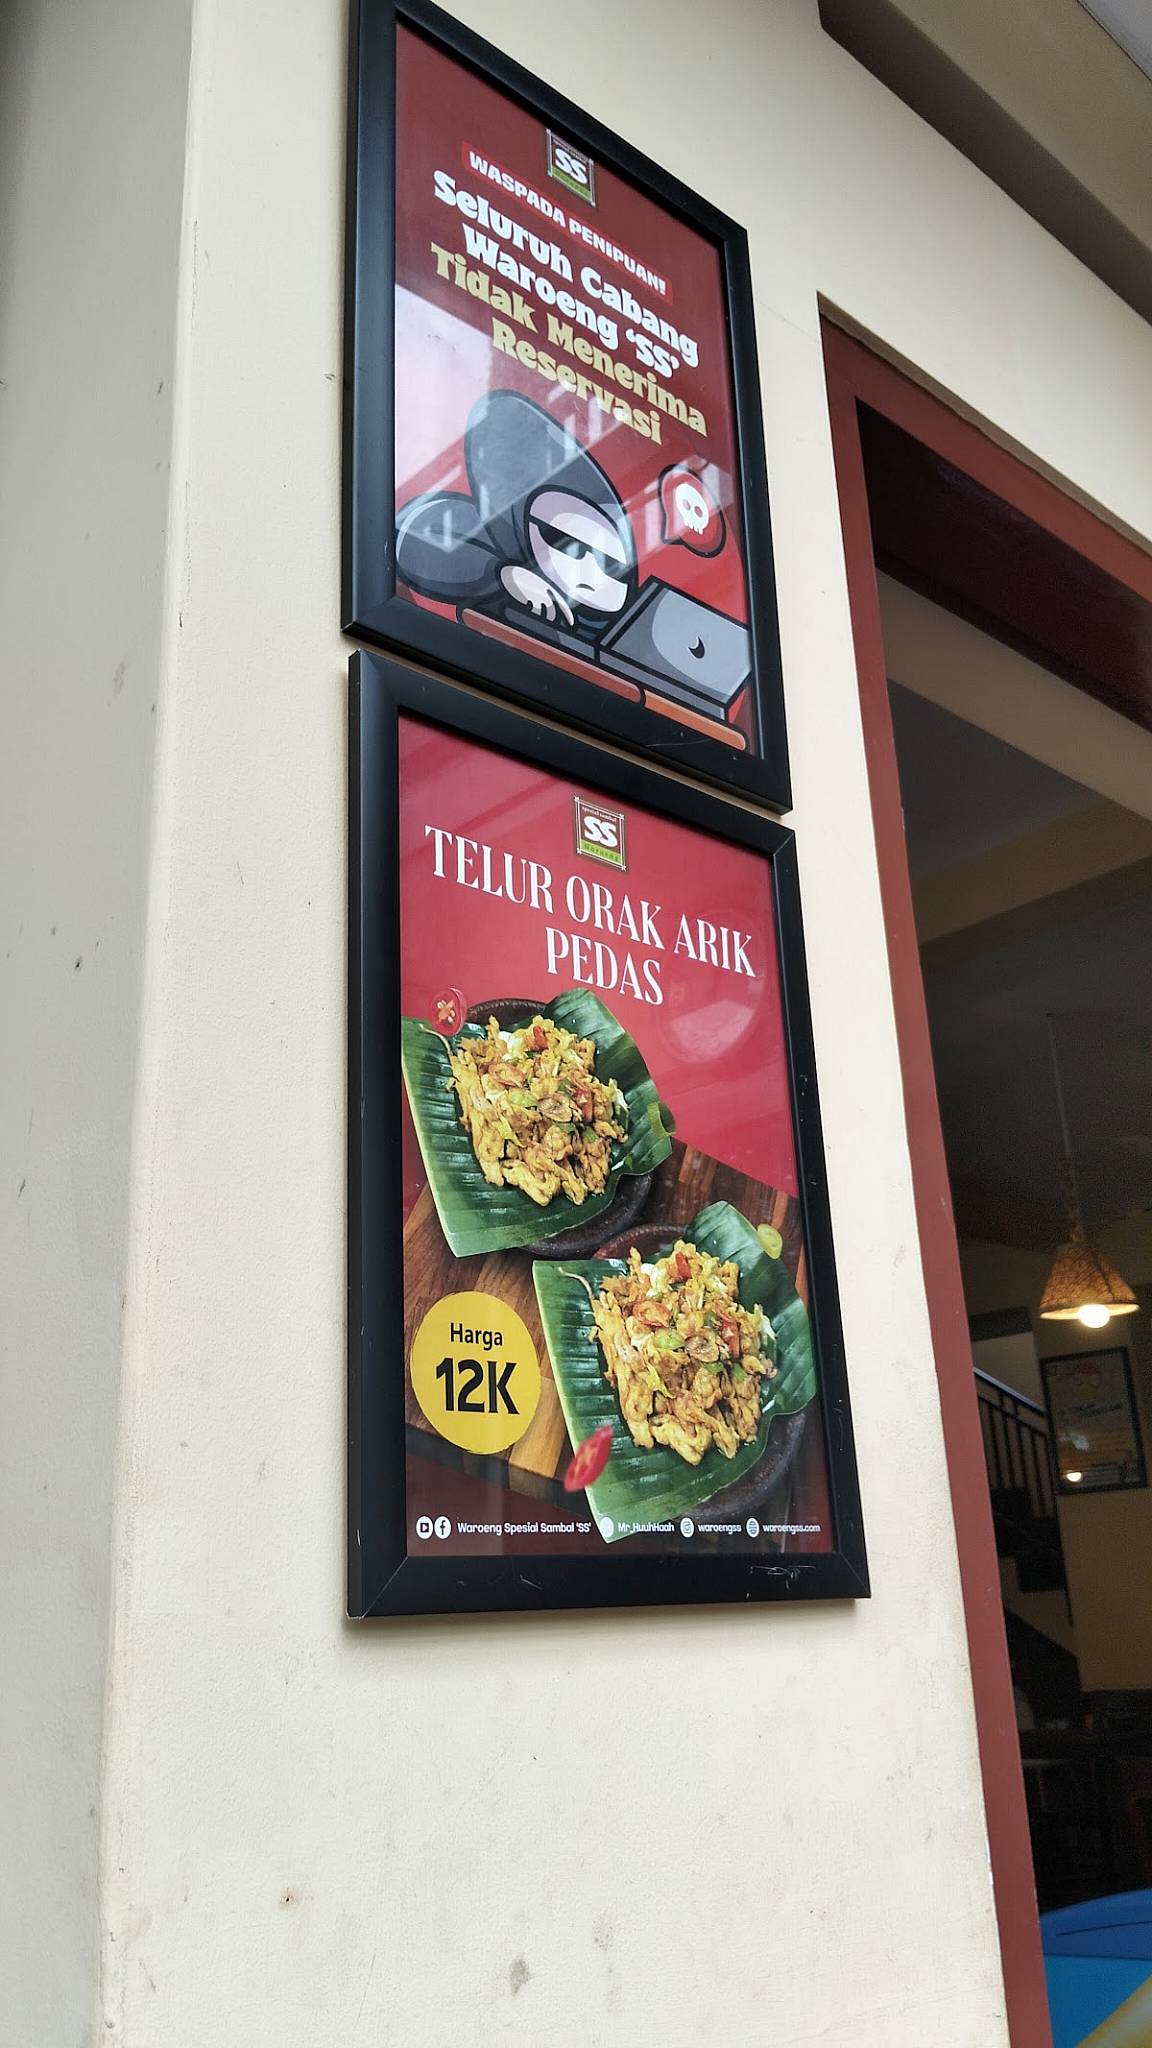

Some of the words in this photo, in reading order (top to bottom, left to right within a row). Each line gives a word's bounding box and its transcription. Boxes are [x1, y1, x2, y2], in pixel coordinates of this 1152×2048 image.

[469, 151, 566, 227] WASPADA
[555, 148, 588, 184] SS
[433, 170, 573, 283] Seluruh
[580, 266, 699, 367] Cabang
[462, 223, 619, 350] Waroeng
[431, 242, 539, 334] Tidak
[546, 313, 708, 437] Menerima
[492, 317, 662, 445] Reservasi
[583, 815, 618, 848] SS
[424, 825, 554, 914] TELUR
[566, 875, 665, 950] ORAK
[673, 913, 756, 977] ARIK
[545, 926, 664, 1005] PEDAS
[450, 1322, 503, 1351] Harga
[435, 1357, 520, 1415] 12K
[457, 1521, 502, 1536] Waroeng
[504, 1521, 539, 1536] Spesial
[540, 1521, 575, 1534] Sambal
[698, 1522, 742, 1536] waroengss
[763, 1522, 821, 1536] waroengss.com
